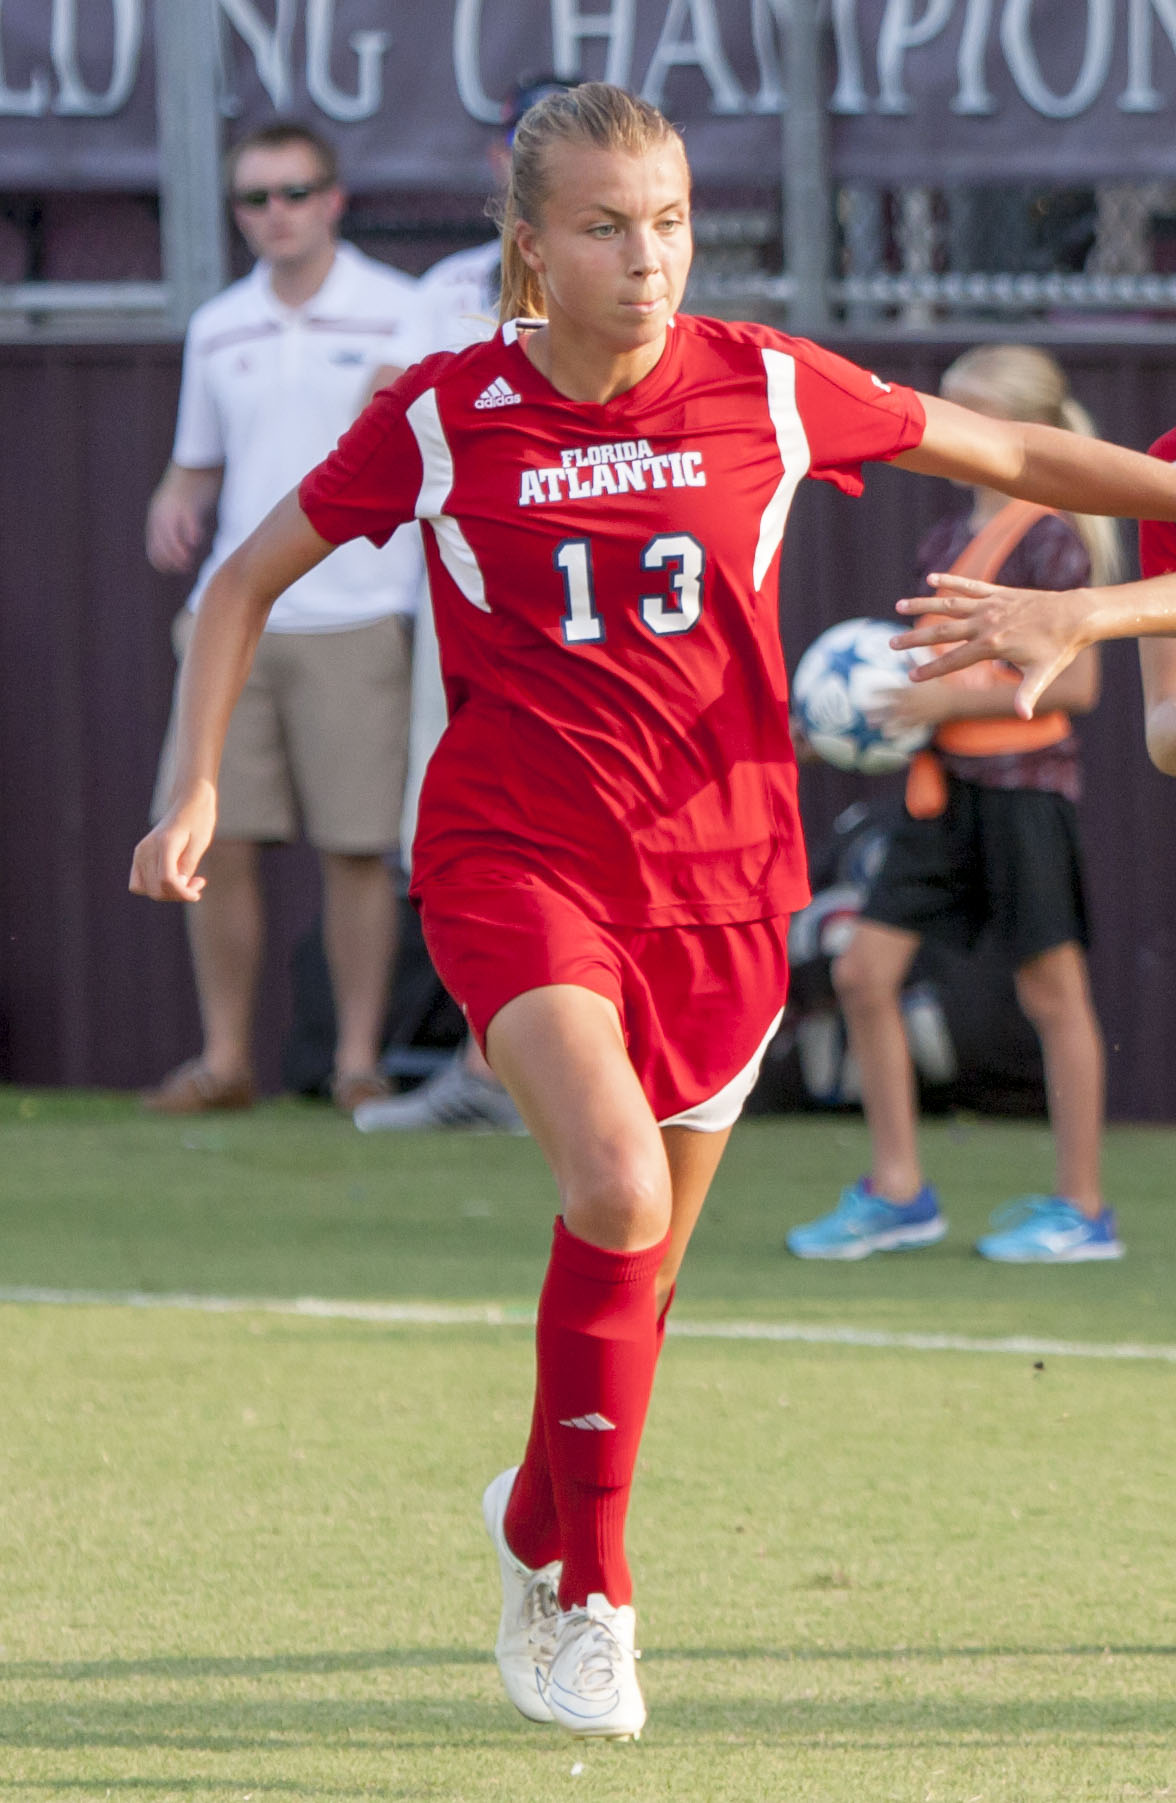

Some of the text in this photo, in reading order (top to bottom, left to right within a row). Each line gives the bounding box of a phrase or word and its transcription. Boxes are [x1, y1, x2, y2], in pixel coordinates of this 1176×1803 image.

[0, 0, 388, 121] LDNG
[474, 393, 522, 410] adidas
[518, 451, 707, 507] ATLANTIC
[560, 438, 655, 468] FLORIDA
[553, 531, 706, 645] 13
